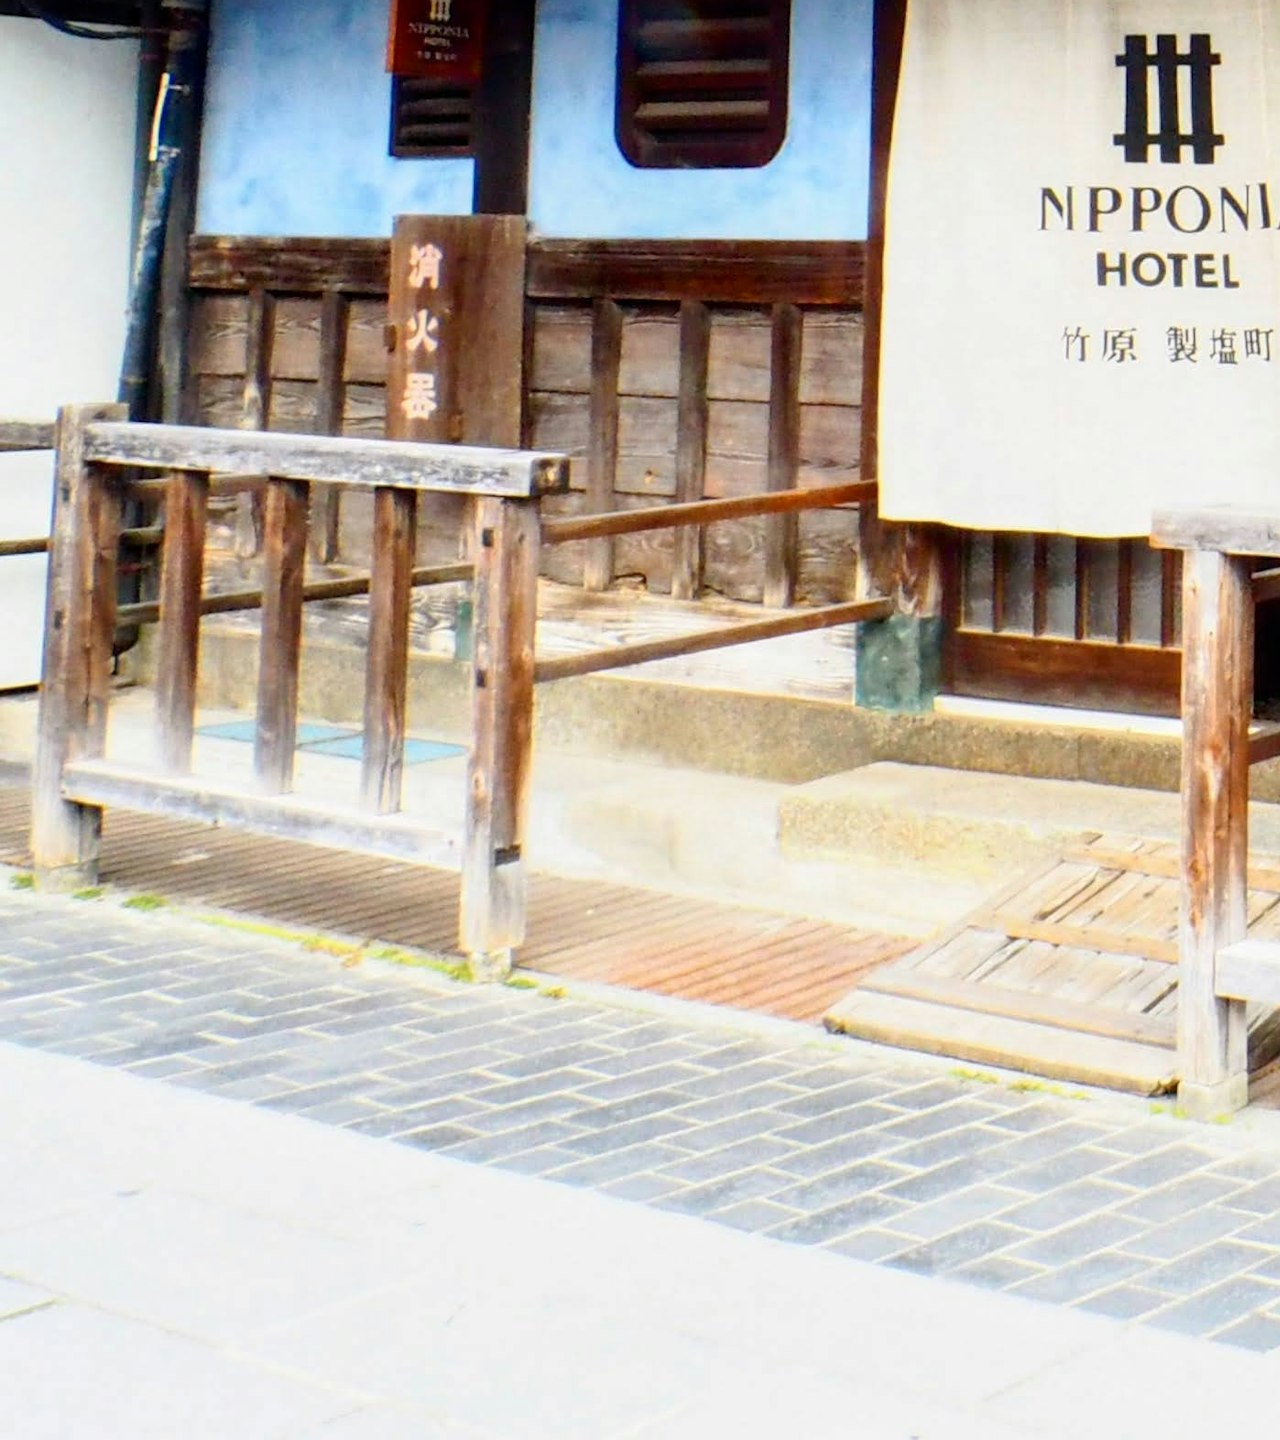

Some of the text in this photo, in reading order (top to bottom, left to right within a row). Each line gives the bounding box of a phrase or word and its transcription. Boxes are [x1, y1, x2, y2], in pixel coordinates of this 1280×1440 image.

[408, 21, 470, 39] NIPPONIA
[1096, 252, 1240, 288] HOTEL
[401, 243, 443, 420] 消火器
[1062, 326, 1274, 364] 竹原 製塩町
